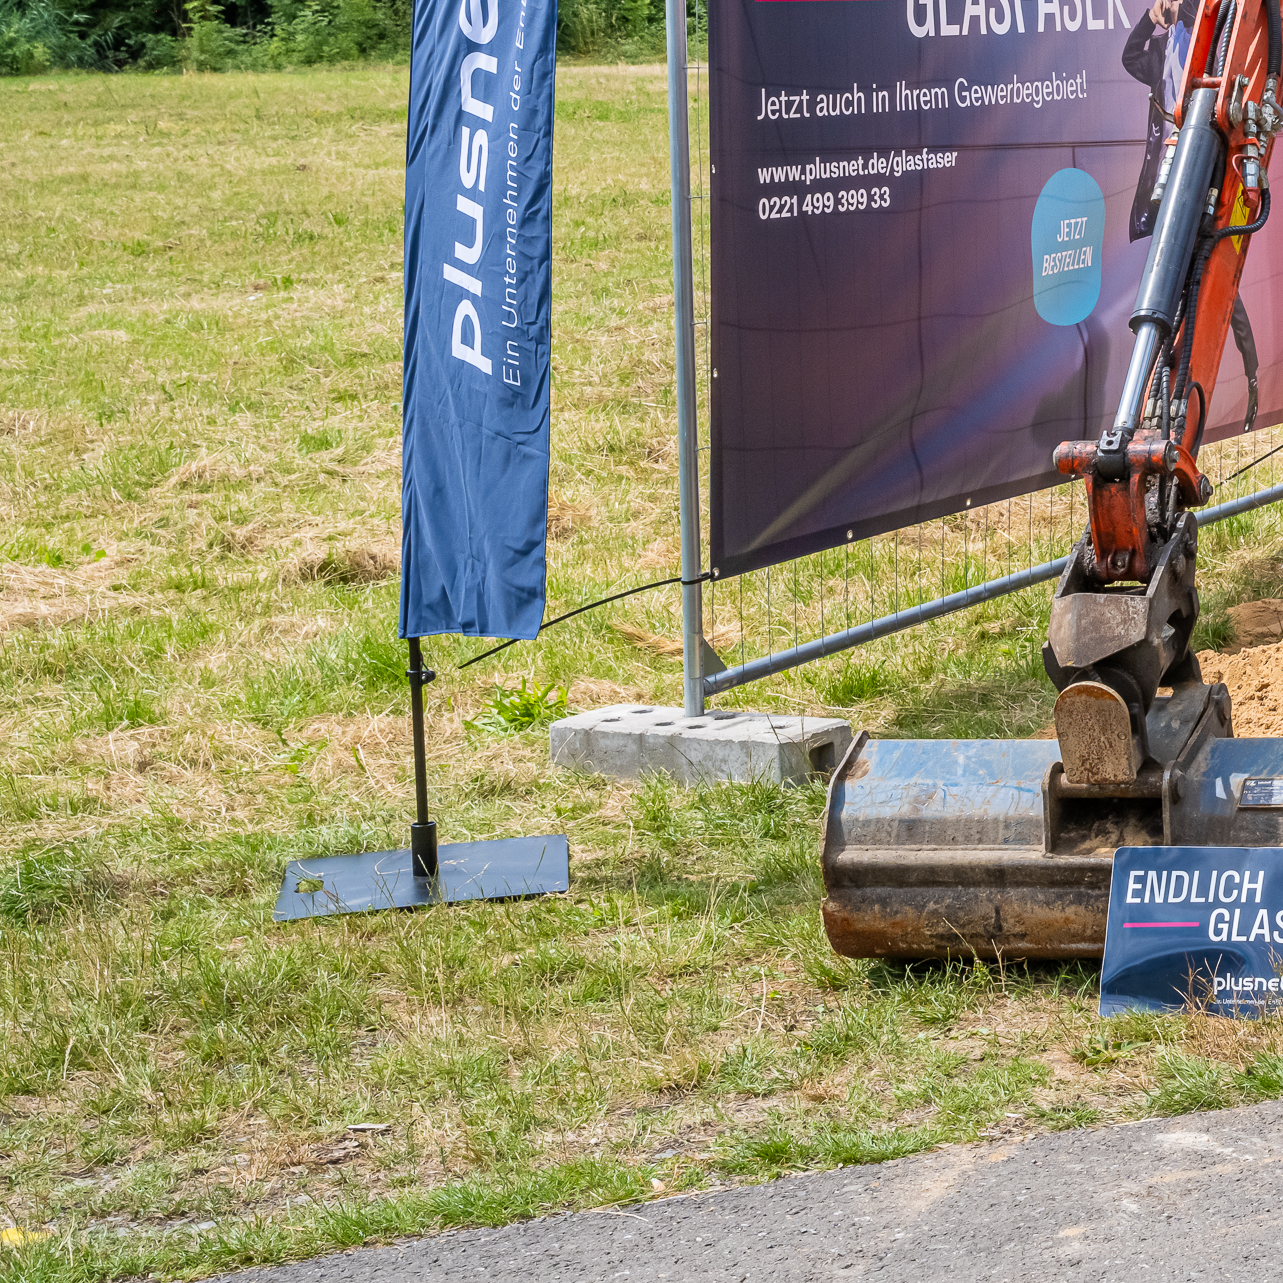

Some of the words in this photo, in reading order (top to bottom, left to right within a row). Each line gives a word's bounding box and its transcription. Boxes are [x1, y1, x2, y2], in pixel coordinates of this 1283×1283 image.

[510, 60, 522, 112] der
[757, 88, 810, 120] Jetzt
[815, 83, 865, 116] auch
[872, 83, 889, 113] in
[896, 80, 949, 111] Ihrem
[954, 70, 1088, 109] Gewerbegebiet!
[758, 148, 958, 185] www.plusnet.de/glasfaser
[758, 195, 798, 220] 0221
[802, 192, 834, 216] 499
[838, 188, 868, 212] 399
[870, 186, 891, 208] 33
[502, 122, 519, 330] Unternehmen
[1056, 216, 1087, 243] JETZT
[1041, 246, 1092, 276] BESTELLEN
[503, 340, 522, 387] Ein
[1126, 870, 1265, 904] ENDLICH
